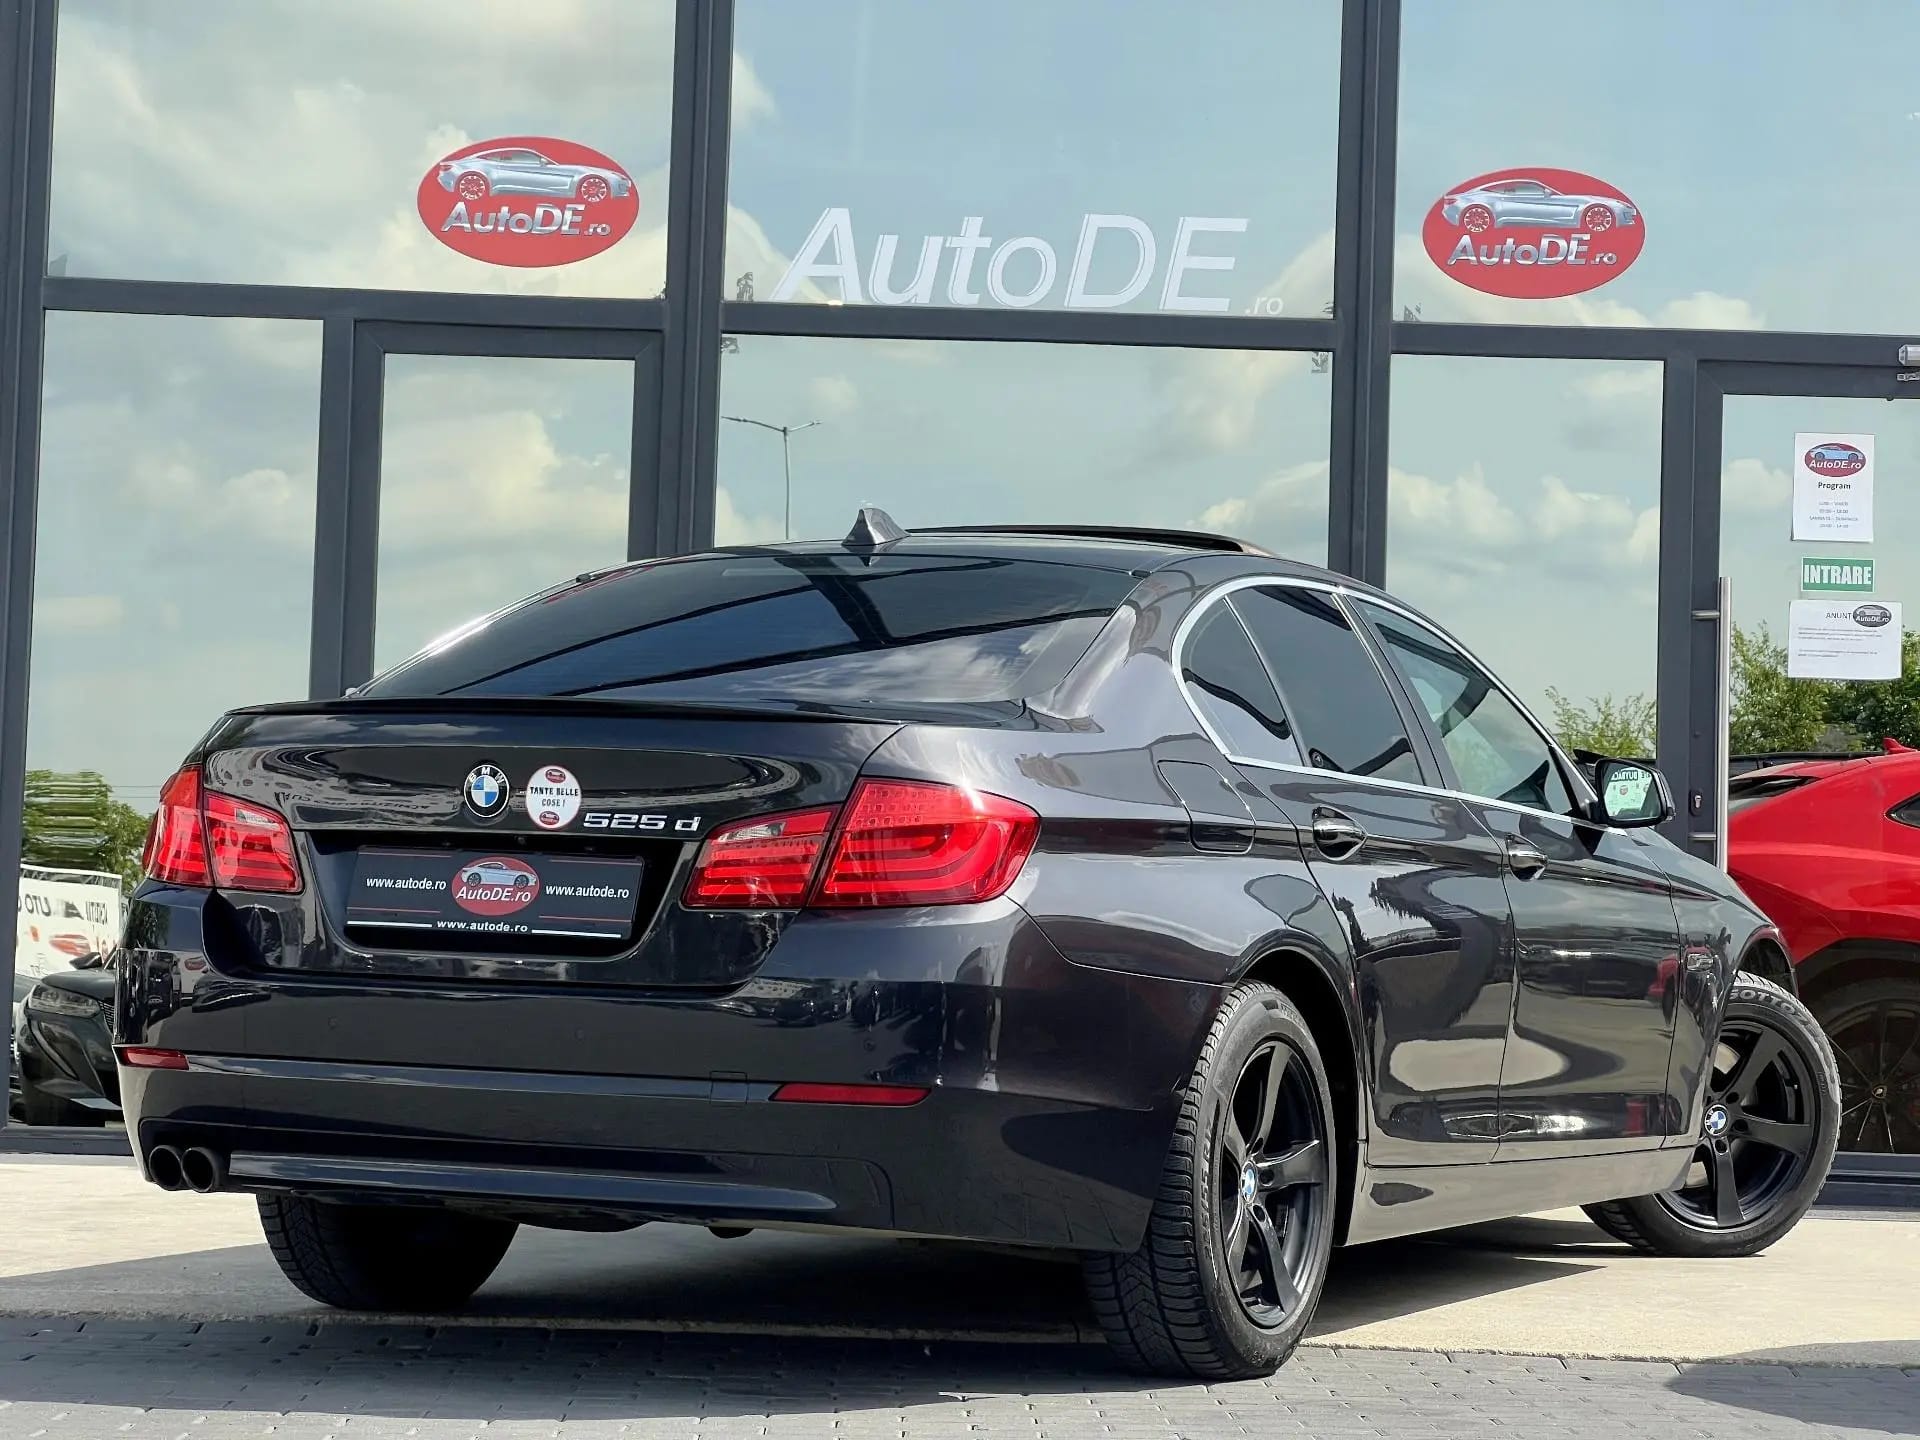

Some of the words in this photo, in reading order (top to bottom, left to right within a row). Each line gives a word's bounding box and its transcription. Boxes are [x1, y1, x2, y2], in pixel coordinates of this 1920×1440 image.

[1808, 460, 1862, 469] AutoDE.ro
[1818, 482, 1851, 490] Program
[1803, 564, 1872, 585] INTRARE
[467, 766, 505, 785] BMW
[529, 786, 553, 796] TANTE
[556, 787, 579, 797] BELLE
[583, 812, 668, 829] 525
[674, 816, 701, 832] d
[365, 875, 447, 890] www.autode.ro
[455, 886, 532, 902] AutoDE.ro
[545, 884, 630, 899] www.autode.ro
[436, 919, 529, 933] www.autode.ro
